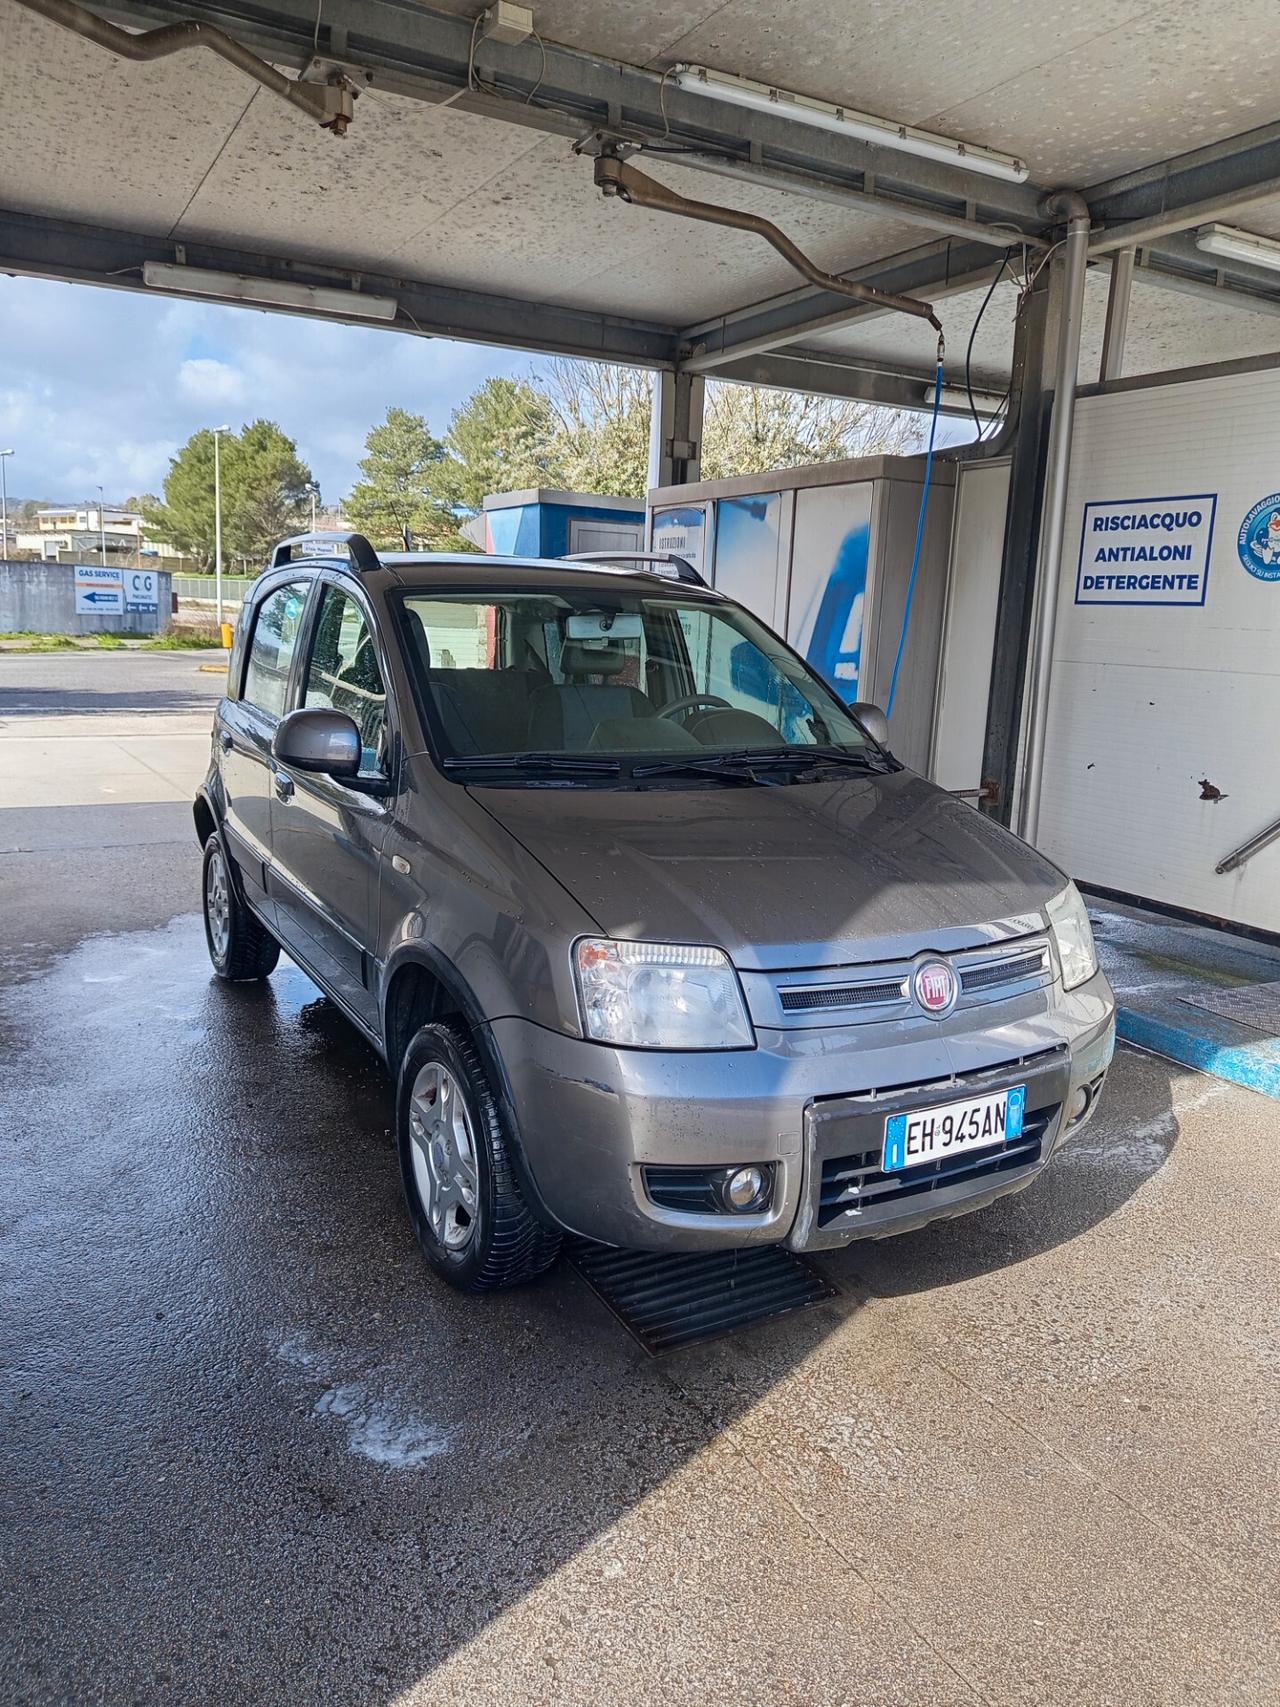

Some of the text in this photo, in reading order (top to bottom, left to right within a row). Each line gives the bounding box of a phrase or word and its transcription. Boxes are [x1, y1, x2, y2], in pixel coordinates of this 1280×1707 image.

[1092, 511, 1203, 532] RISCIACQUO
[1094, 545, 1192, 562] ANTIALONI
[1083, 574, 1200, 590] DETERGENTE
[924, 975, 947, 1000] FIAT
[907, 1118, 936, 1156] EH
[941, 1101, 1007, 1147] 945AN
